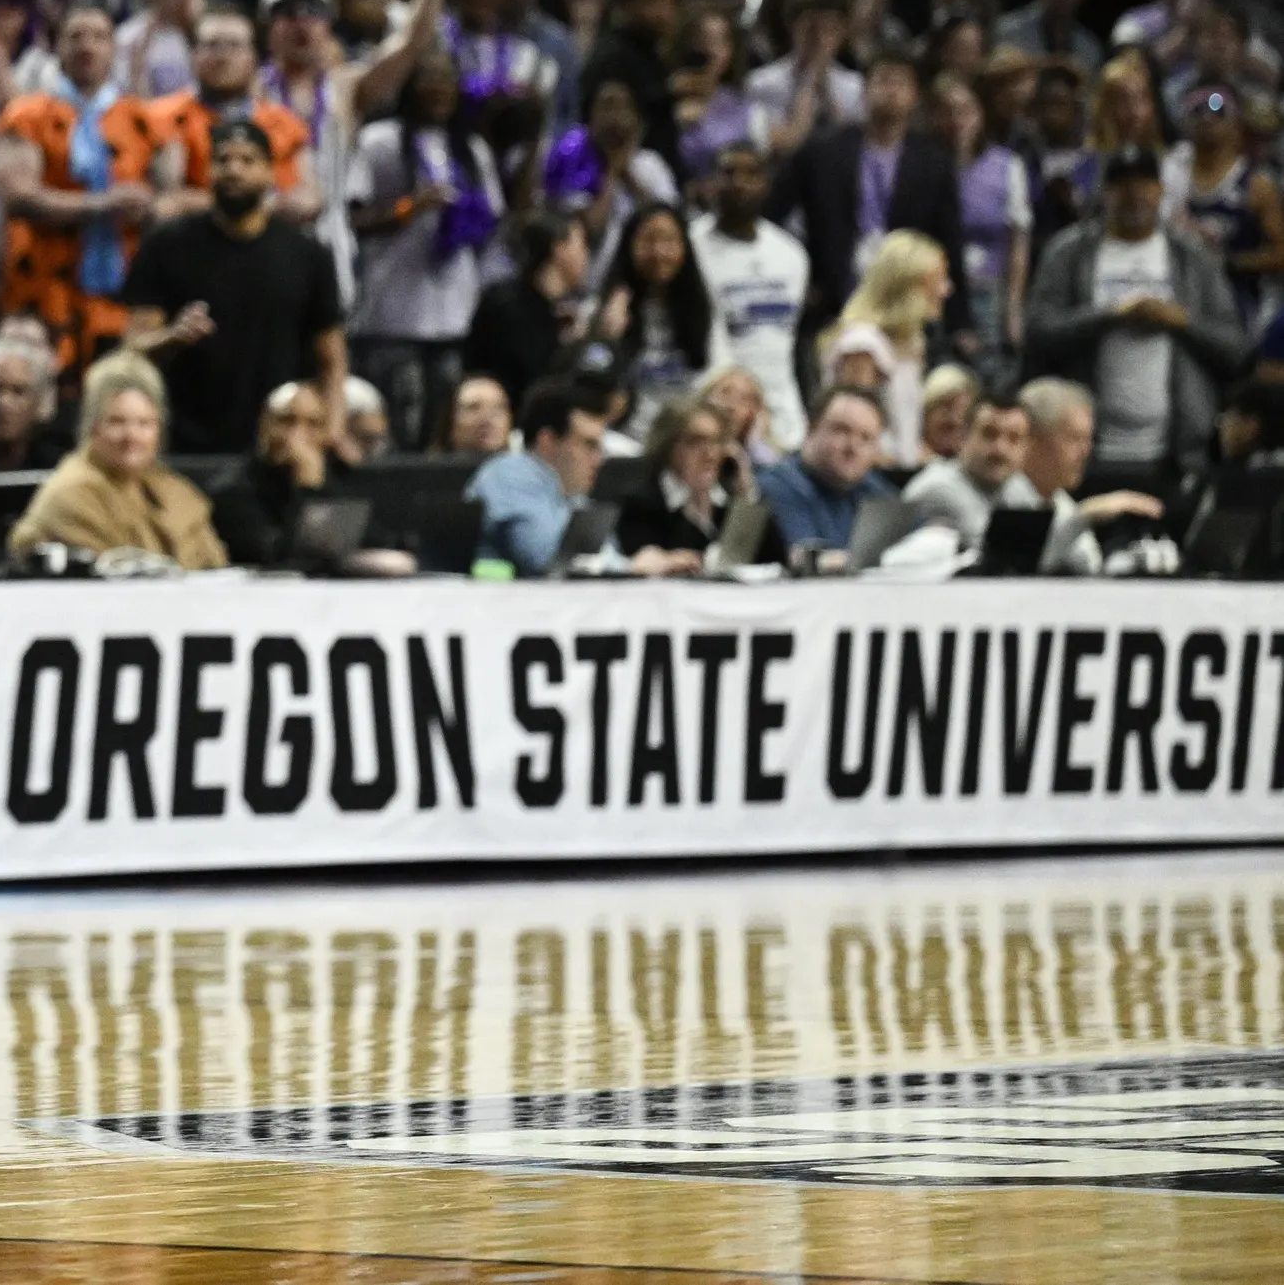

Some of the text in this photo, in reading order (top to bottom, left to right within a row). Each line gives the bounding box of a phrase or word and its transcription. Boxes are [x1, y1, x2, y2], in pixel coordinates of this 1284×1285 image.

[4, 625, 1284, 825] OREGON STATE UNIVERSI
